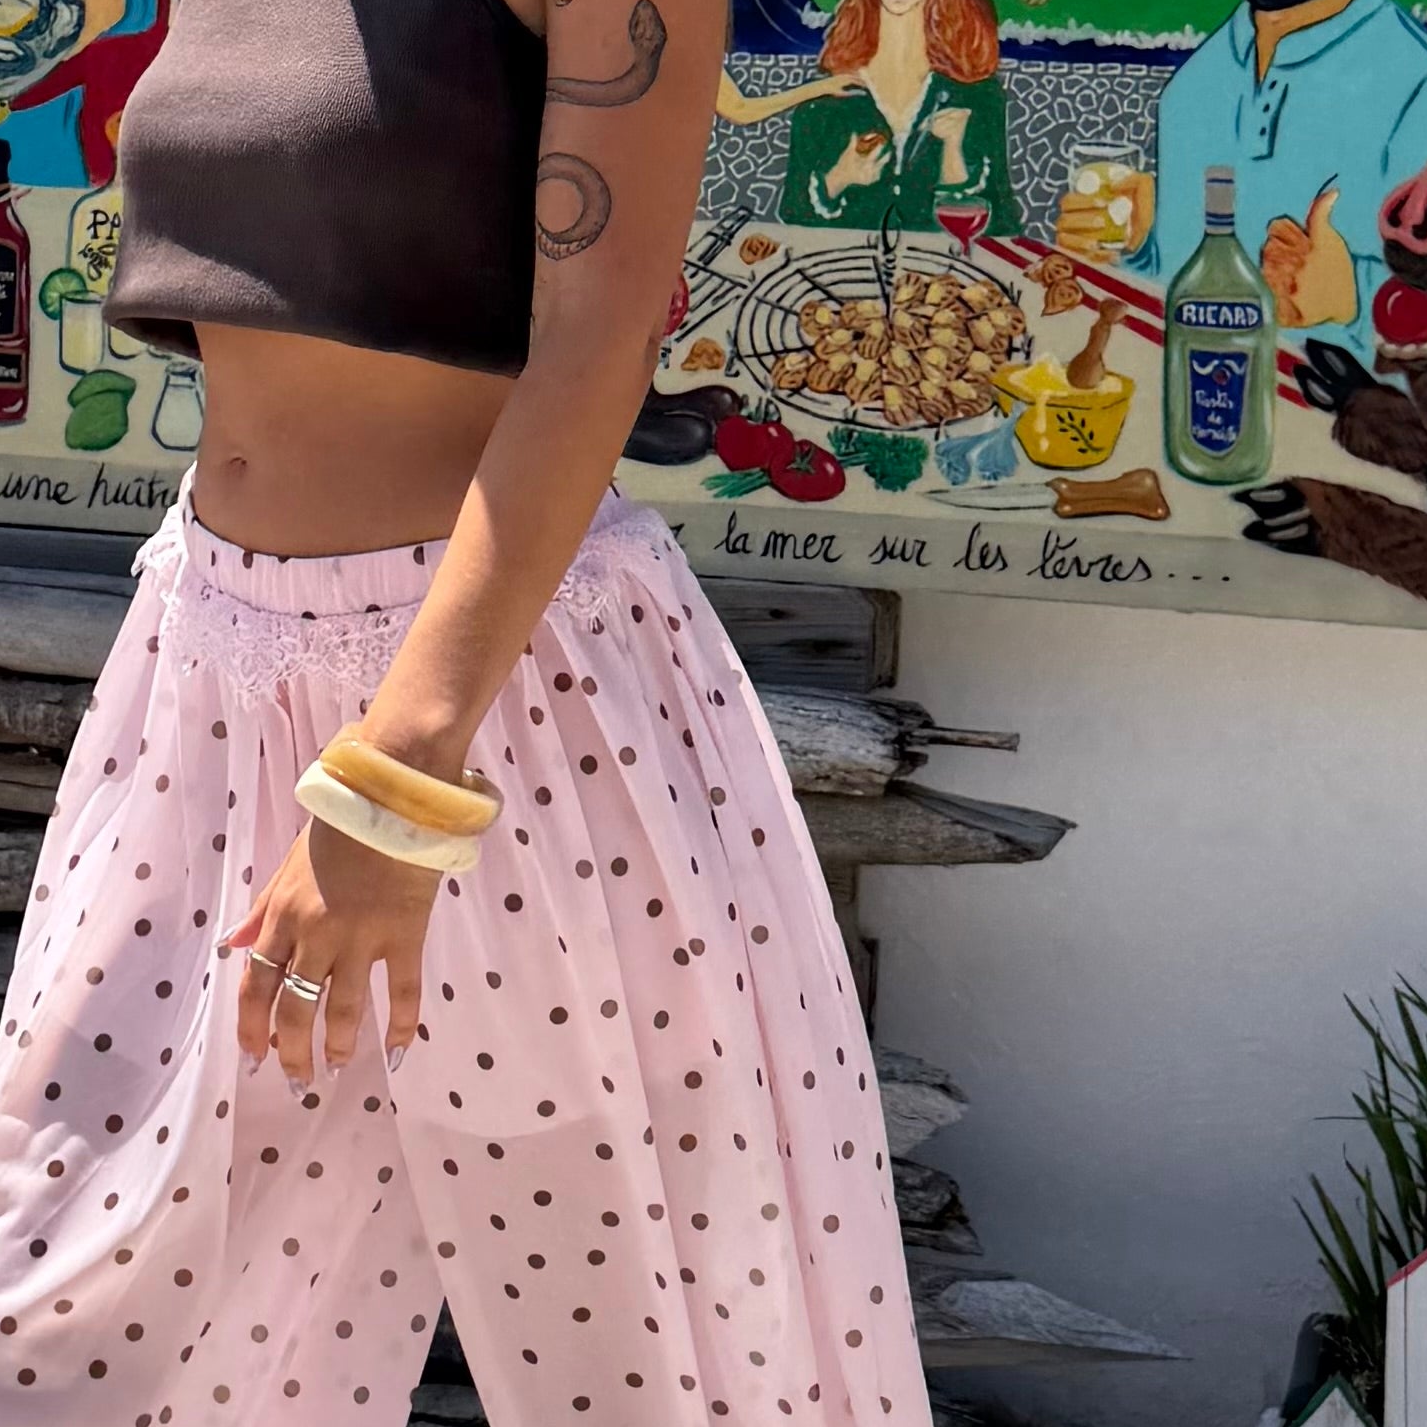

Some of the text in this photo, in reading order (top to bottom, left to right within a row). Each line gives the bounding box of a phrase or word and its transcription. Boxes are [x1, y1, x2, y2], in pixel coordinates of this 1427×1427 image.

[713, 510, 752, 554] la
[760, 529, 844, 563] mer
[871, 535, 931, 567] sur
[953, 522, 1008, 571] les
